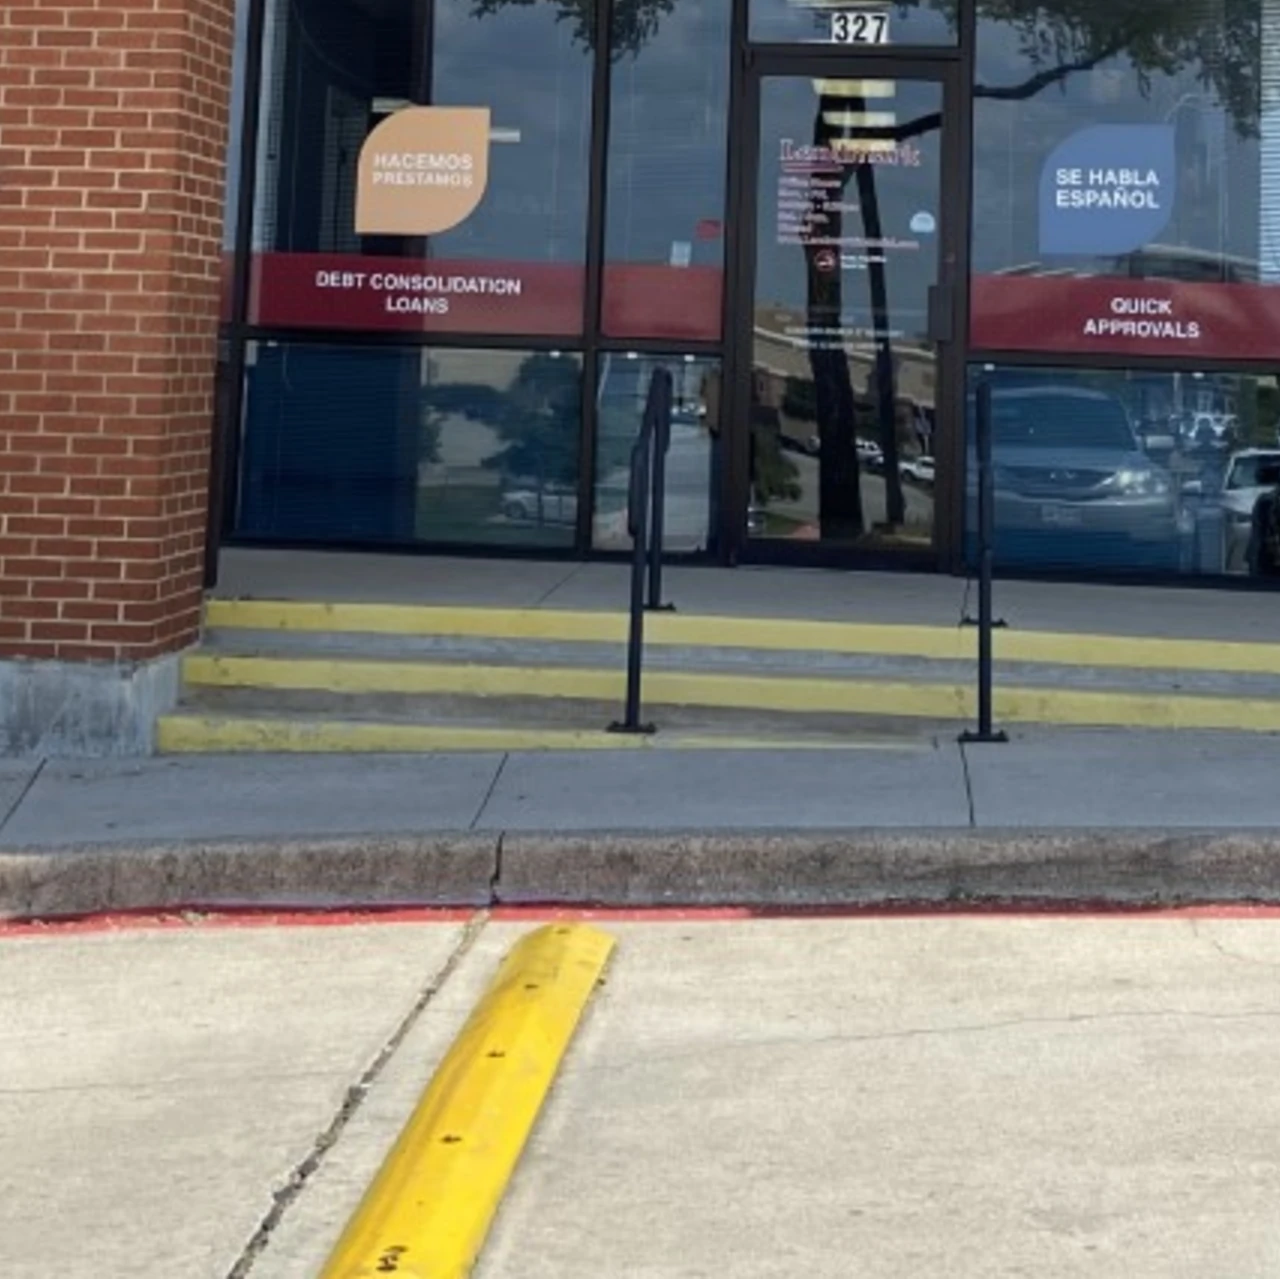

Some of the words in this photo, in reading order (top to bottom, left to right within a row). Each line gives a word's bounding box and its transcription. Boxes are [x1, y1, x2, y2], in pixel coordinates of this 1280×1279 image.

[834, 14, 886, 43] 327
[373, 153, 473, 170] HACEMOS
[1056, 167, 1082, 186] SE
[1089, 168, 1160, 187] HABLA
[1056, 186, 1160, 209] ESPAÑOL
[315, 271, 367, 289] DEBT
[370, 273, 521, 295] CONSOLIDATION
[385, 296, 449, 314] LOANS
[1110, 297, 1172, 315] QUICK
[1083, 318, 1200, 338] APPROVALS
